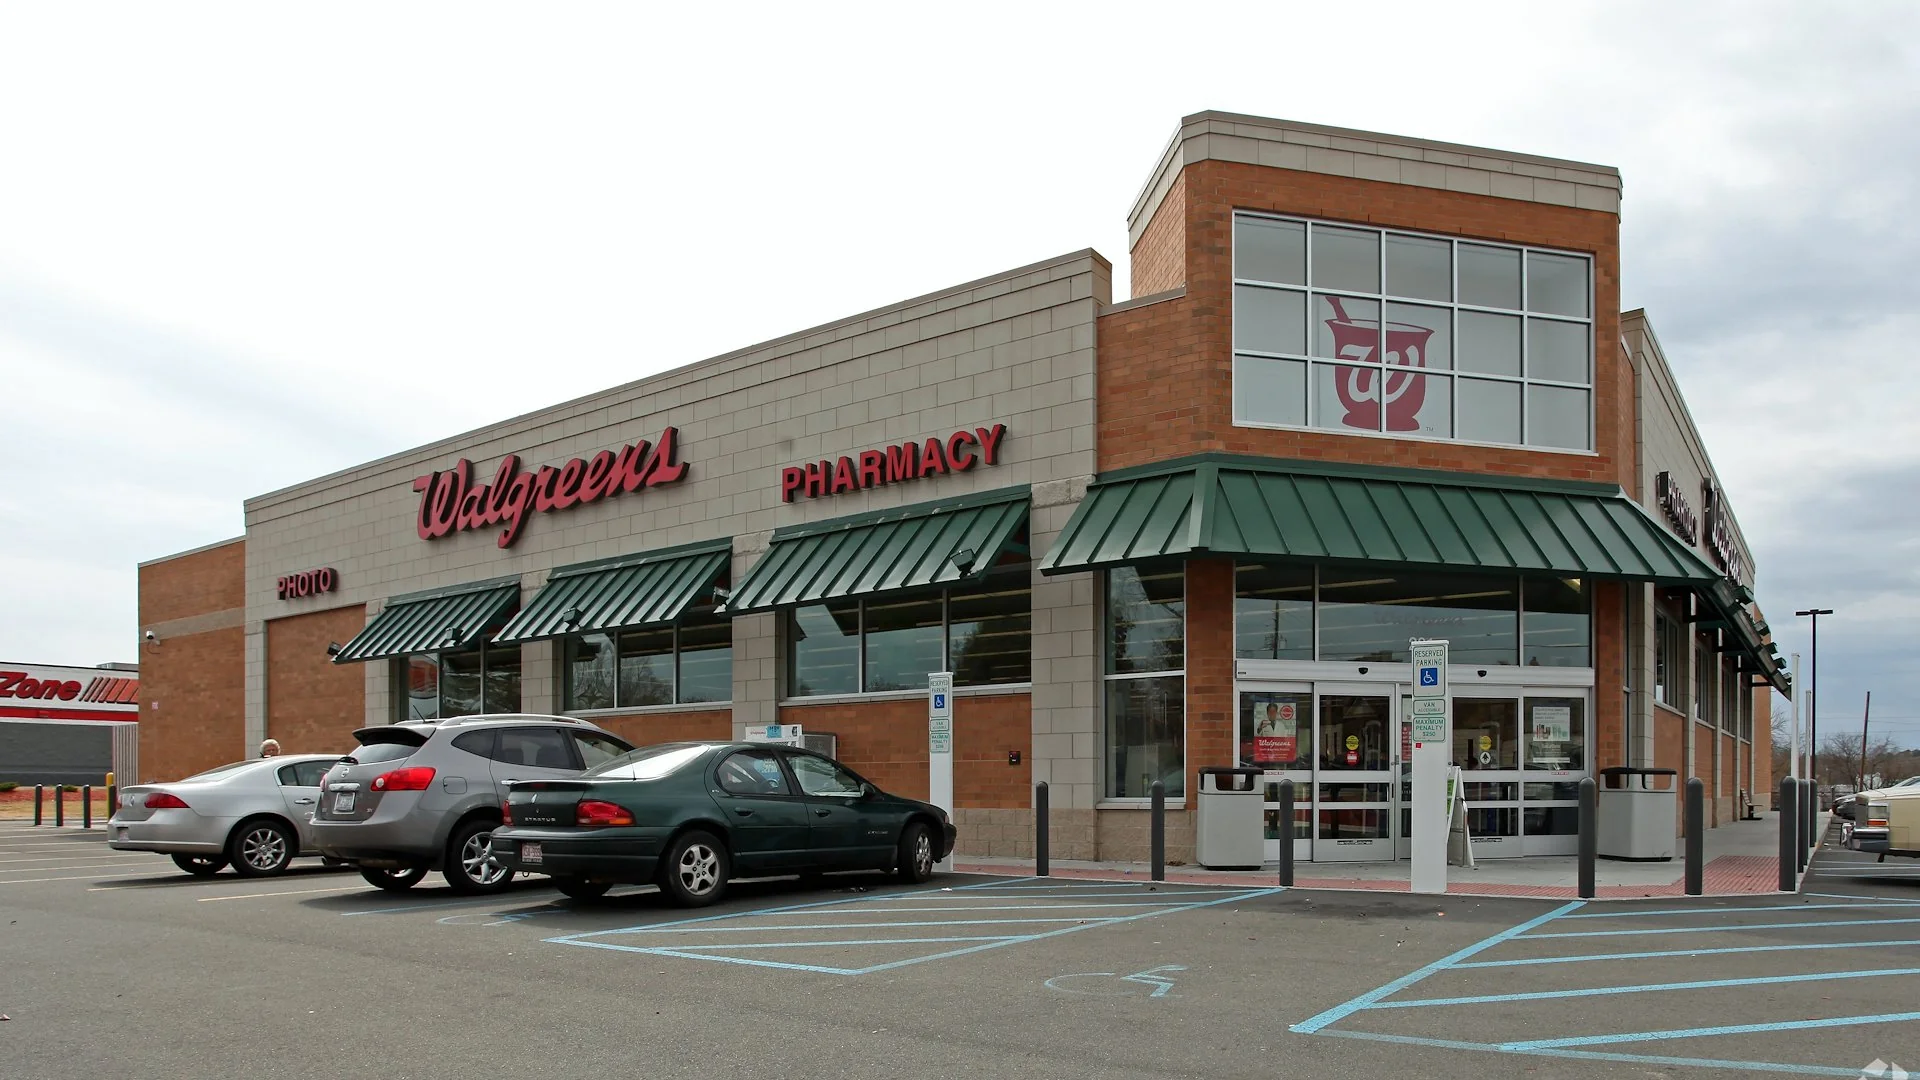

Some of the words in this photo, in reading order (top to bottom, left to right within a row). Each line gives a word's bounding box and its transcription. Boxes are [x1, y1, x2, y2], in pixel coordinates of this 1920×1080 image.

[782, 423, 1007, 503] PHARMACY
[413, 426, 690, 549] Walgreens
[277, 567, 338, 600] PHOTO
[1415, 649, 1443, 657] RESERVED
[1258, 739, 1292, 748] Walgreens
